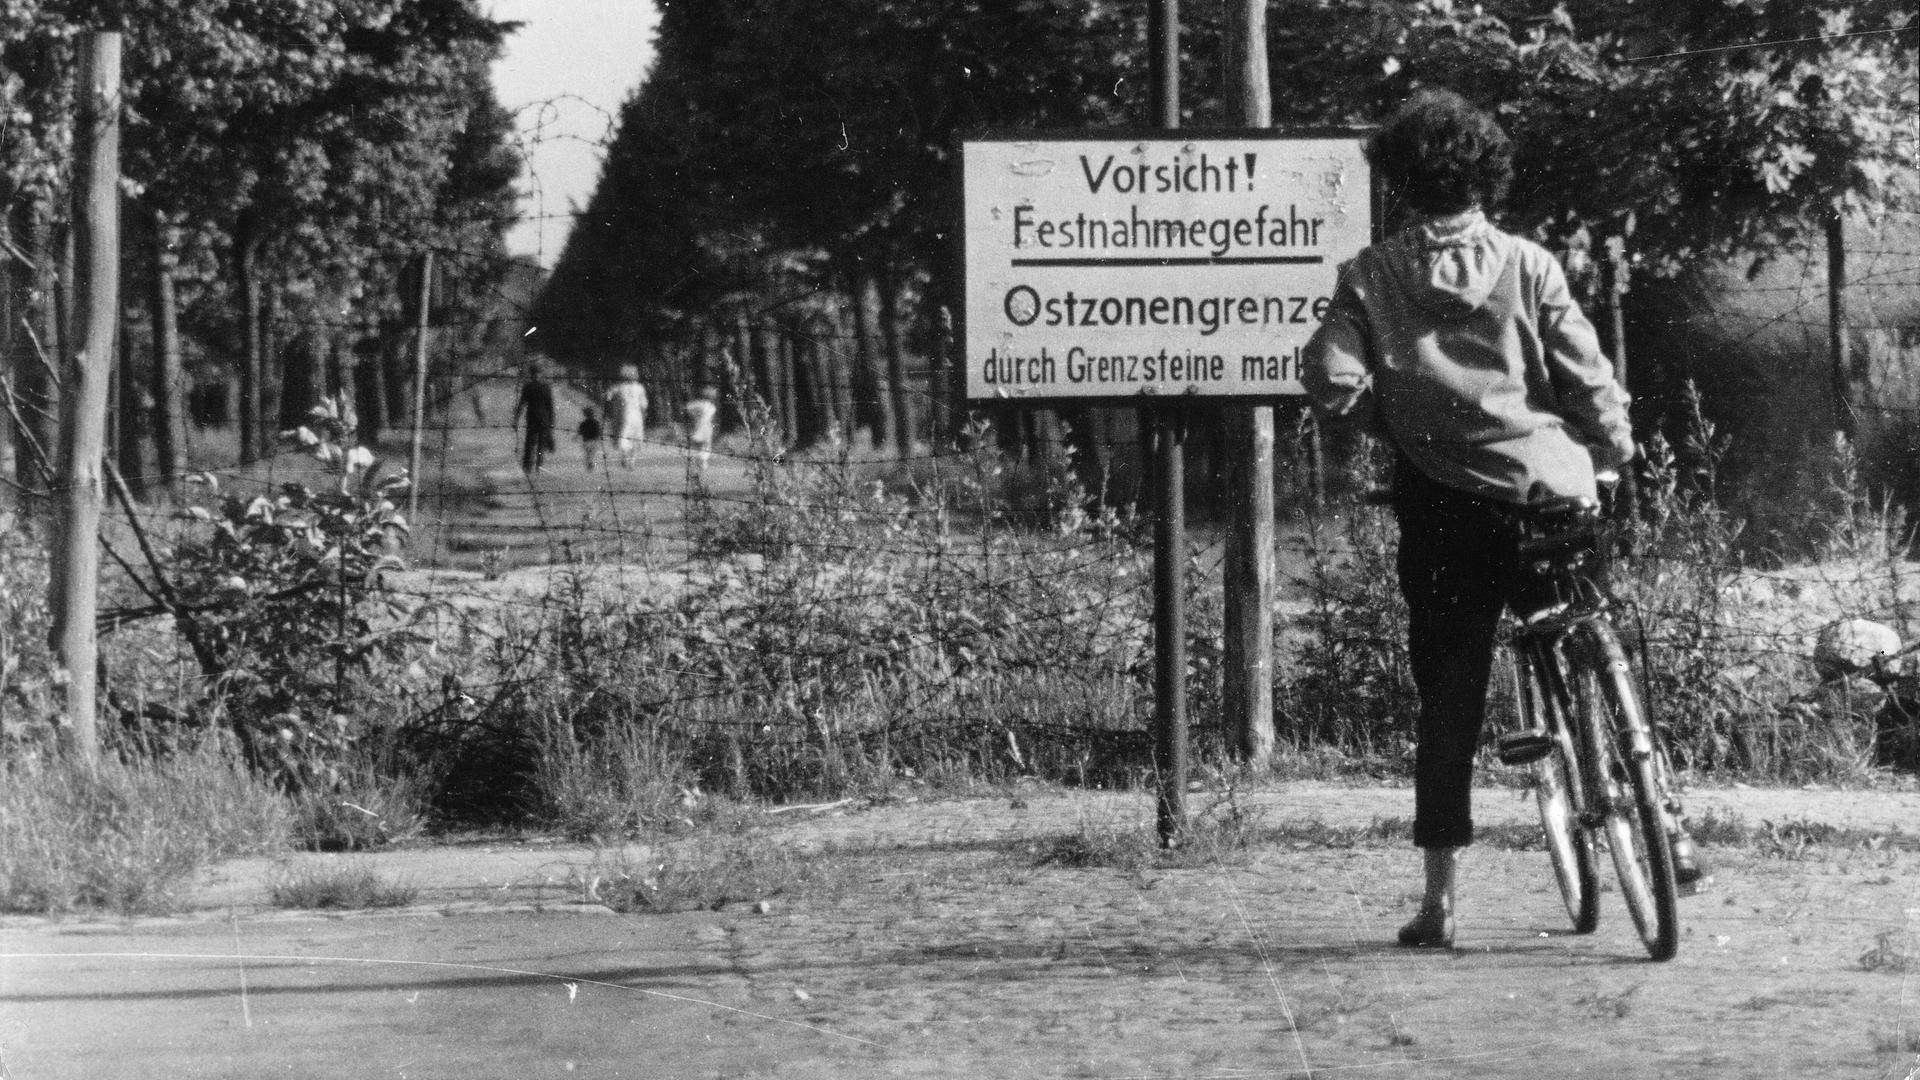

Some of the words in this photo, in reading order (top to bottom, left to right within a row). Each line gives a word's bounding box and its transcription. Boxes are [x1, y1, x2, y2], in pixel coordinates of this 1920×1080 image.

[1079, 153, 1258, 194] Vorsicht!
[1013, 205, 1324, 257] Festnahmegefahr
[1004, 284, 1331, 336] Ostzonengrenze
[983, 347, 1056, 384] durch
[1066, 346, 1224, 383] Grenzsteine
